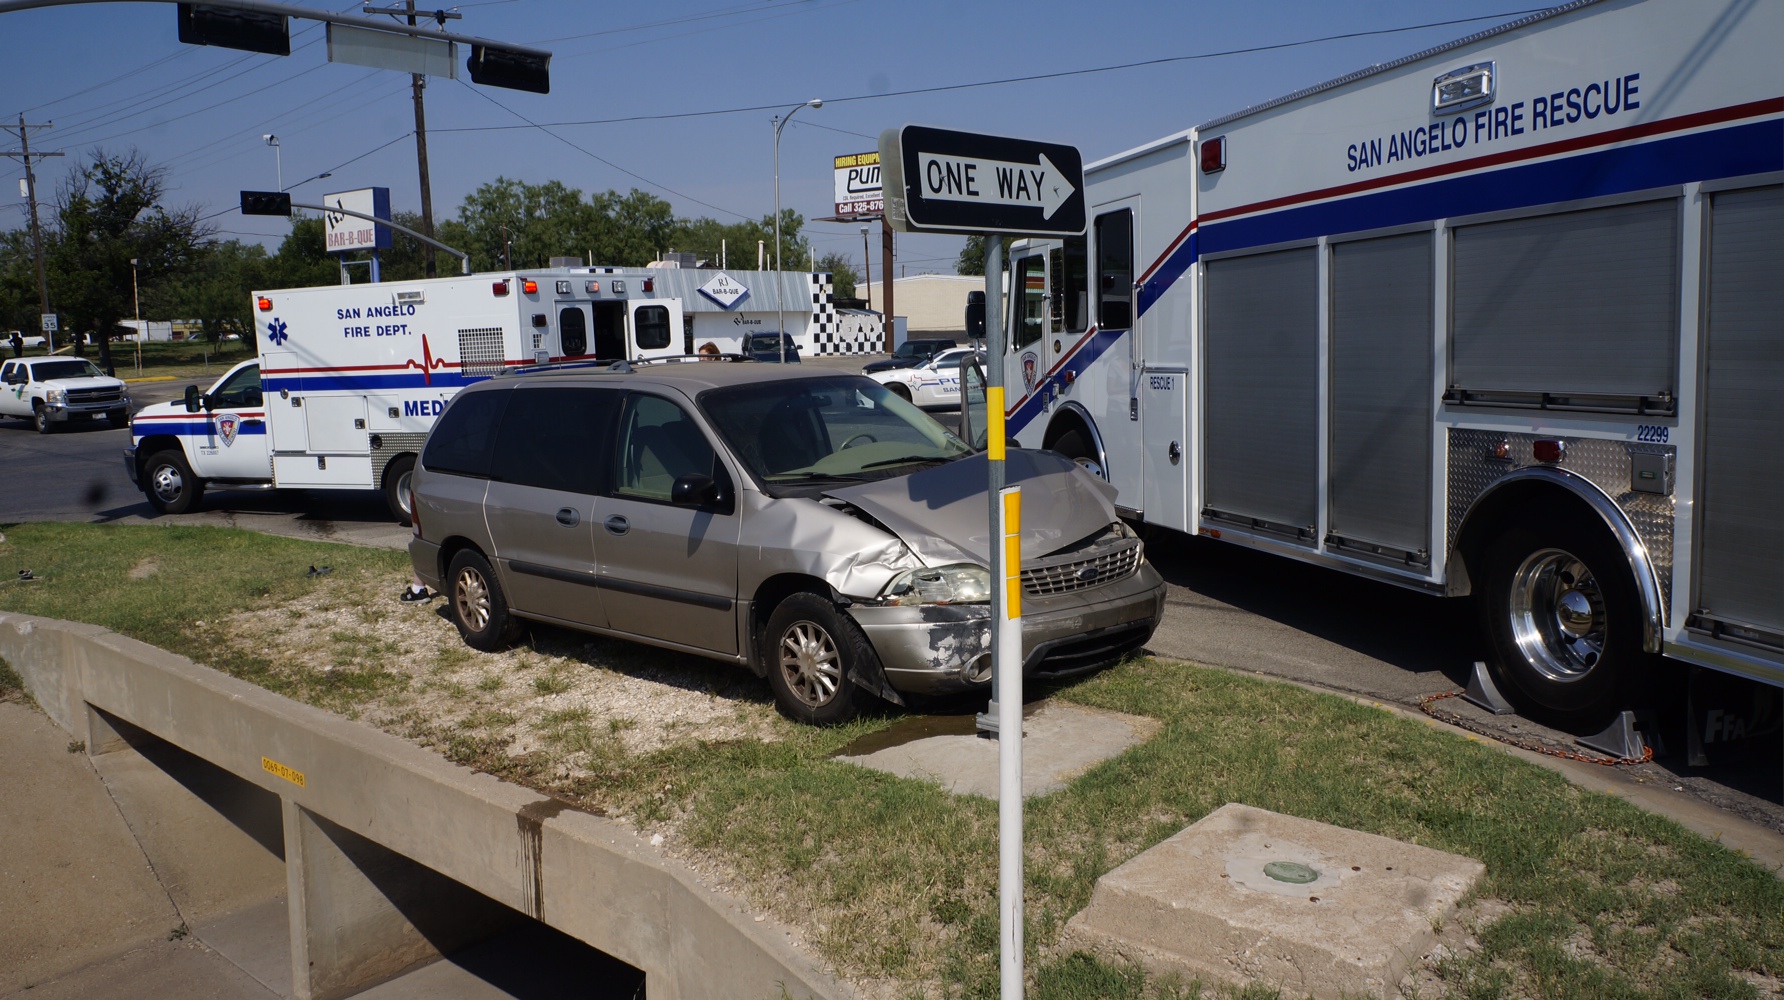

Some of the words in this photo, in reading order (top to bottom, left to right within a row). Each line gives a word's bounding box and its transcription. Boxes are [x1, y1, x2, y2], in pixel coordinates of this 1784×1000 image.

[1347, 137, 1382, 172] SAN
[1387, 116, 1467, 164] ANGELO
[1474, 102, 1525, 144] FIRE
[1532, 73, 1640, 131] RESCUE
[835, 155, 857, 168] HIRING
[927, 159, 980, 197] ONE
[996, 166, 1045, 202] WAY
[839, 203, 852, 213] Call
[328, 229, 374, 247] BAR-B-QUE
[717, 277, 729, 287] RJ
[337, 307, 361, 320] SAN
[366, 304, 416, 318] ANGELO
[344, 326, 371, 338] FIRE
[376, 324, 412, 337] DEPT.
[1150, 376, 1171, 390] RESCUE
[1637, 424, 1669, 443] 22299
[263, 758, 304, 786] 0069-07-098
